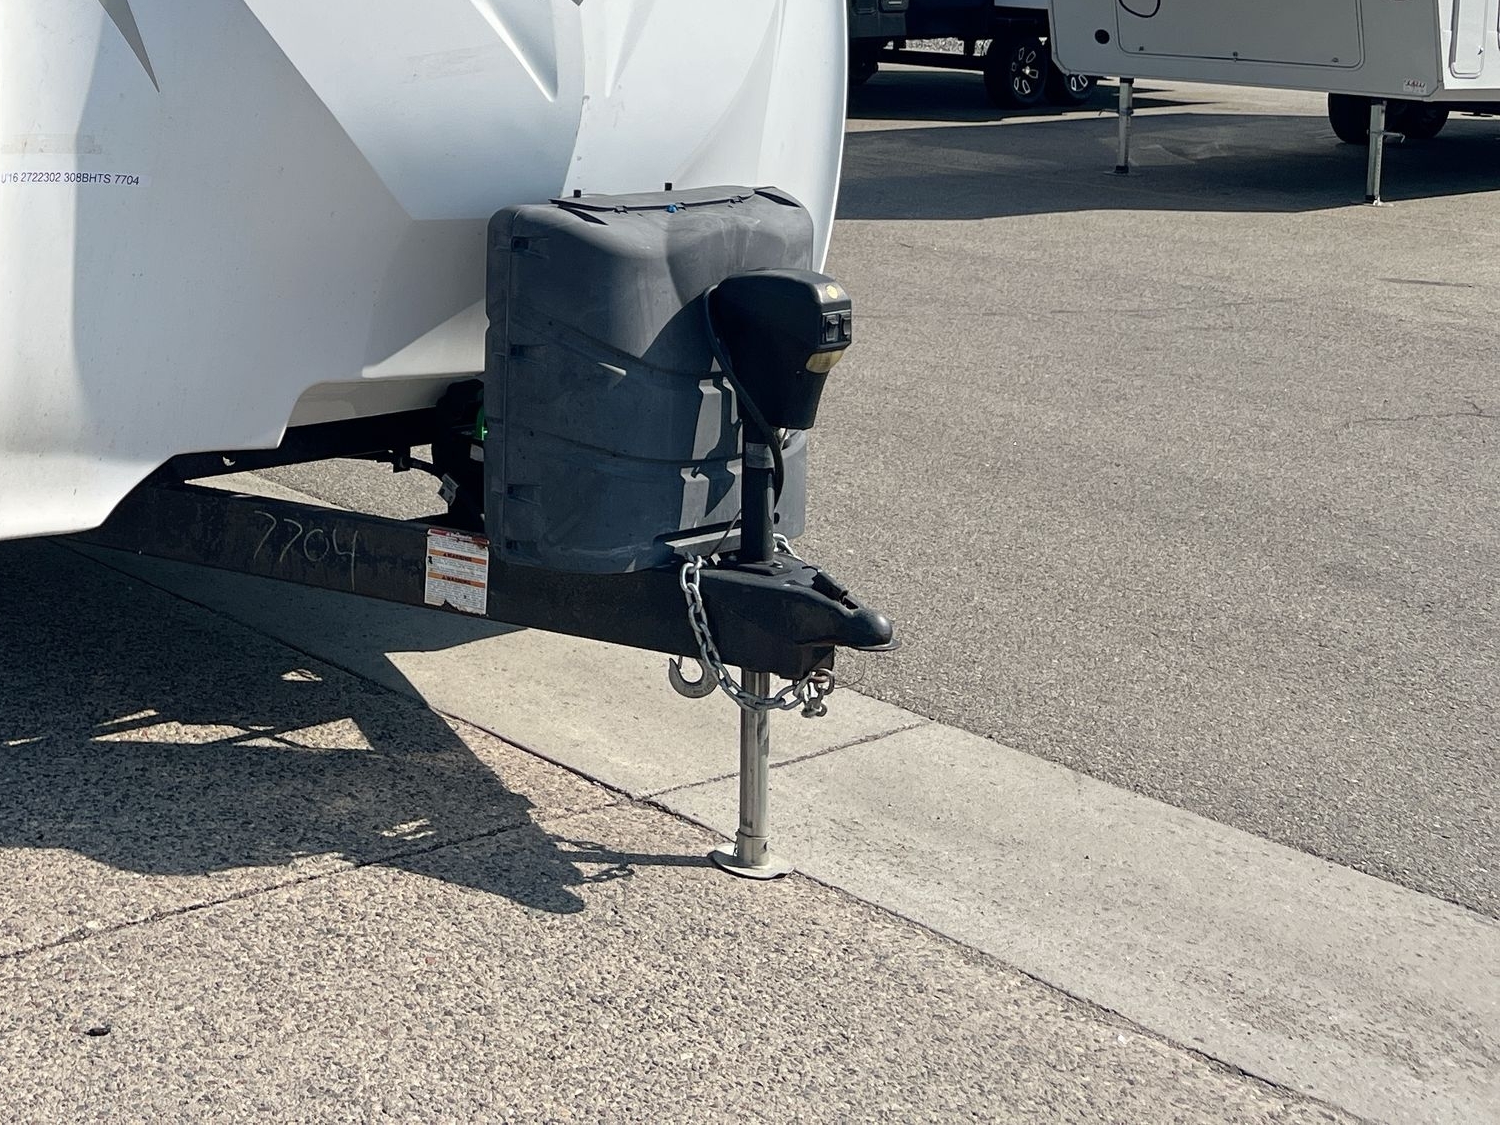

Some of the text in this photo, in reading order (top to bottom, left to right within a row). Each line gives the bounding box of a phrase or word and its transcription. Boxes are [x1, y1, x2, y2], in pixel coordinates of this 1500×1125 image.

[20, 172, 61, 183] 2722302
[63, 172, 111, 184] 308BHTS
[114, 175, 140, 186] 7704
[254, 510, 358, 591] 7704
